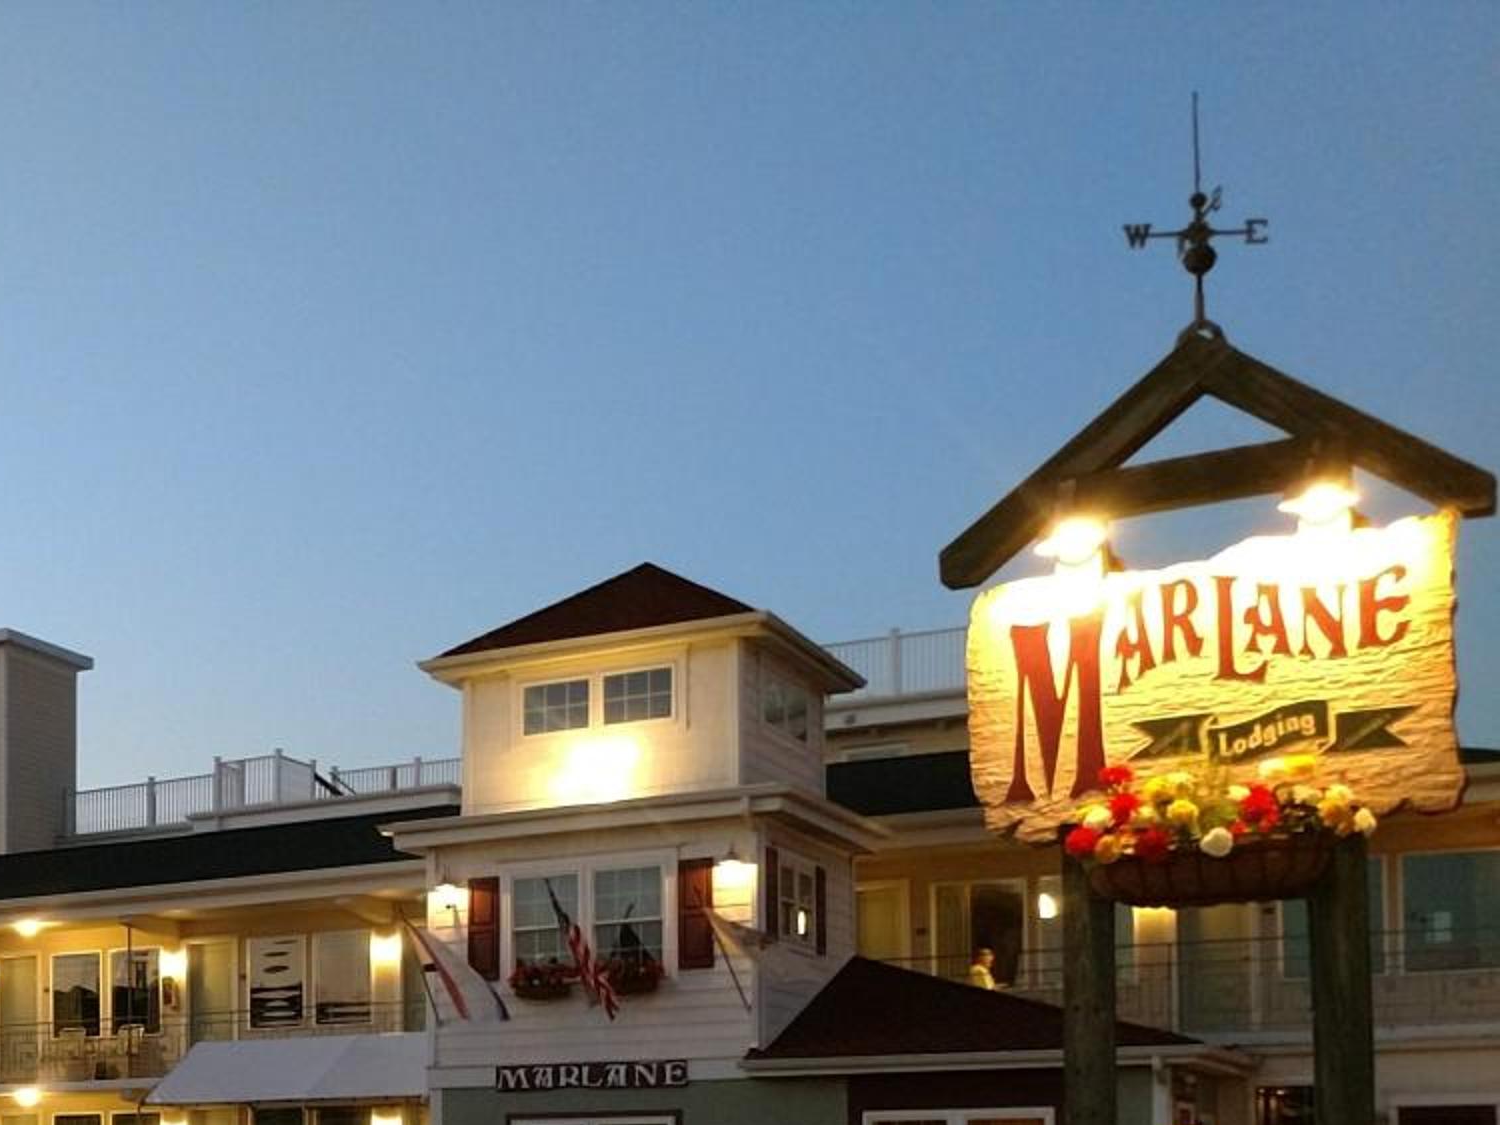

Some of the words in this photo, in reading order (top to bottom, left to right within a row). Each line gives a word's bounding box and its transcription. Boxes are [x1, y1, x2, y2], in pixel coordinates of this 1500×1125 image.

[1122, 223, 1152, 249] W
[1246, 218, 1269, 244] E
[1218, 713, 1317, 757] Lodging
[498, 1061, 688, 1089] MARLANE
